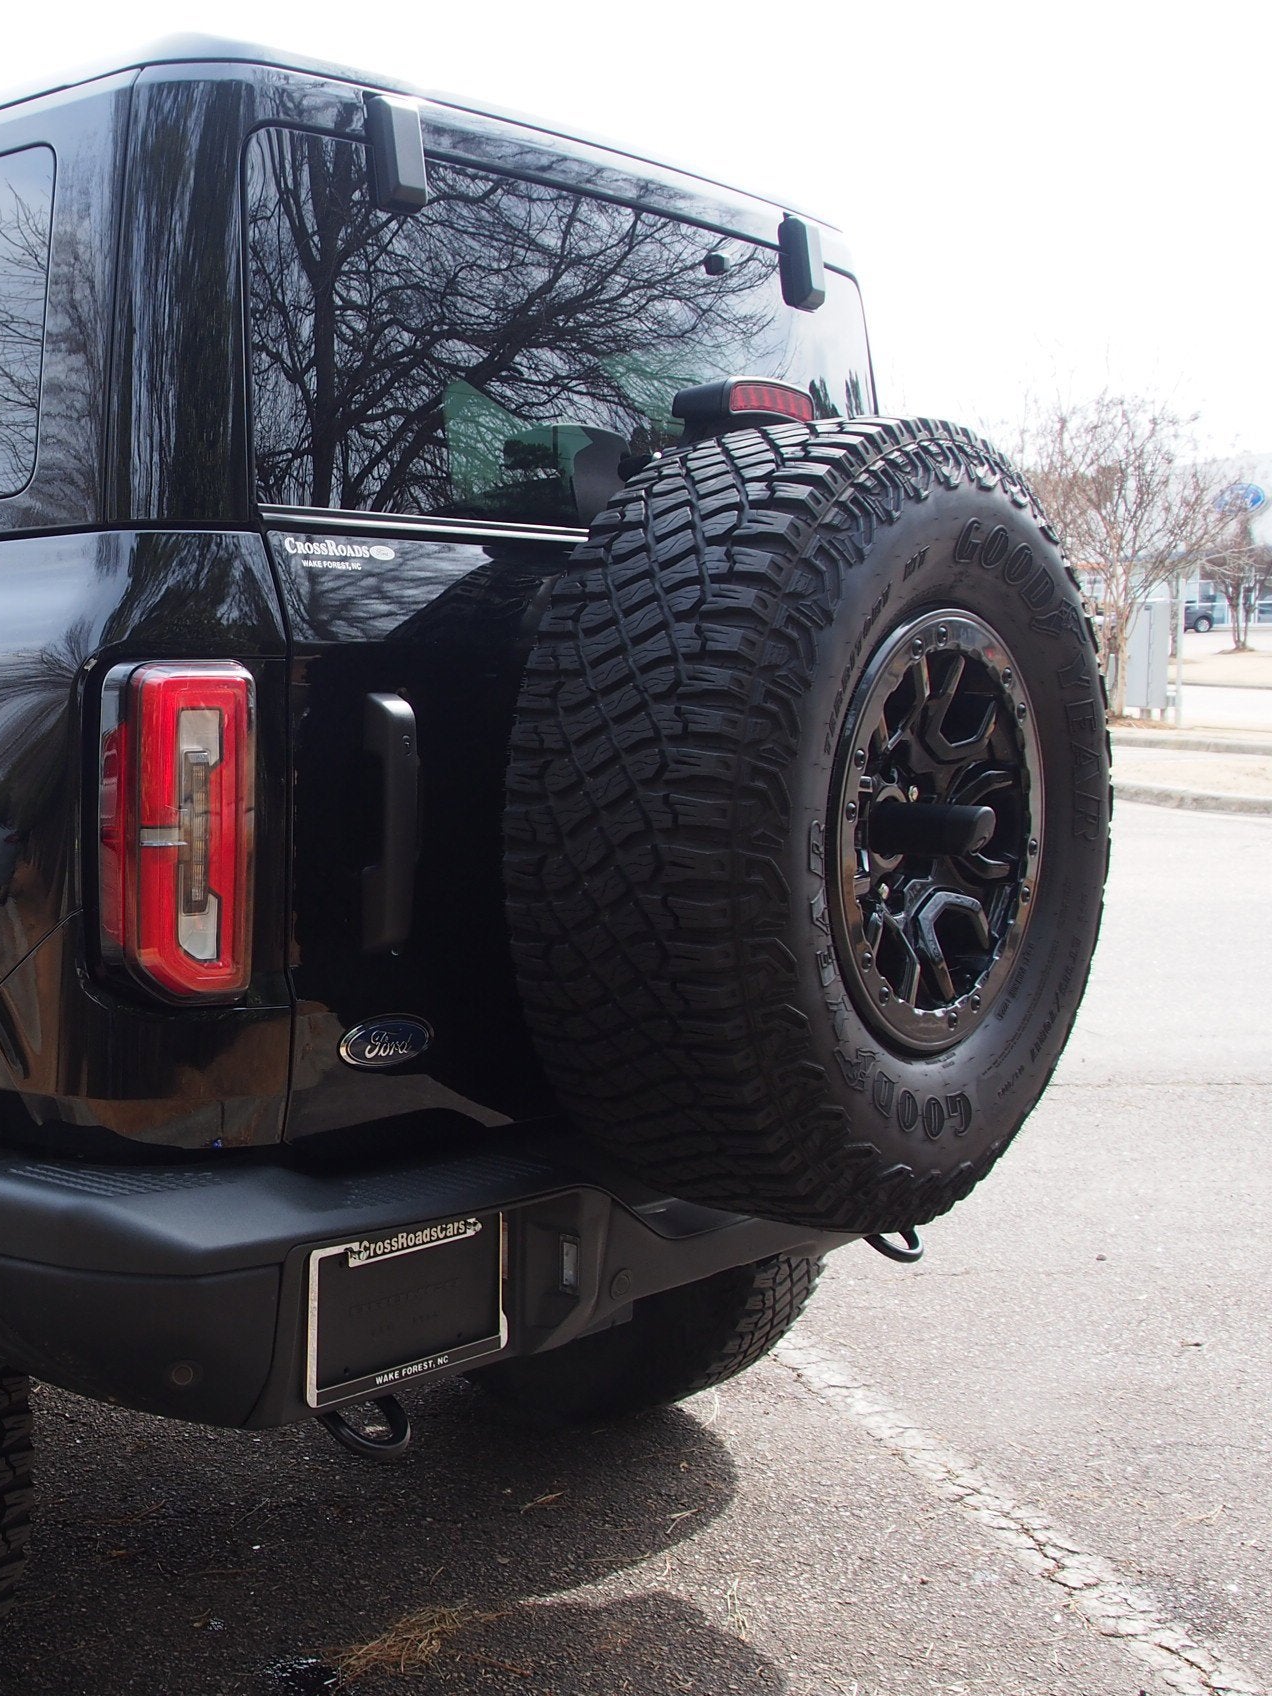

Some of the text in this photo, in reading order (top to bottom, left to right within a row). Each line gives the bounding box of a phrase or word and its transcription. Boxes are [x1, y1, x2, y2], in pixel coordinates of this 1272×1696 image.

[301, 559, 362, 571] WAKE FOREST, NC
[365, 1030, 413, 1059] Ford
[360, 1220, 465, 1260] CrossRoadsCars
[375, 1355, 449, 1385] WAKE FOREST, NC
